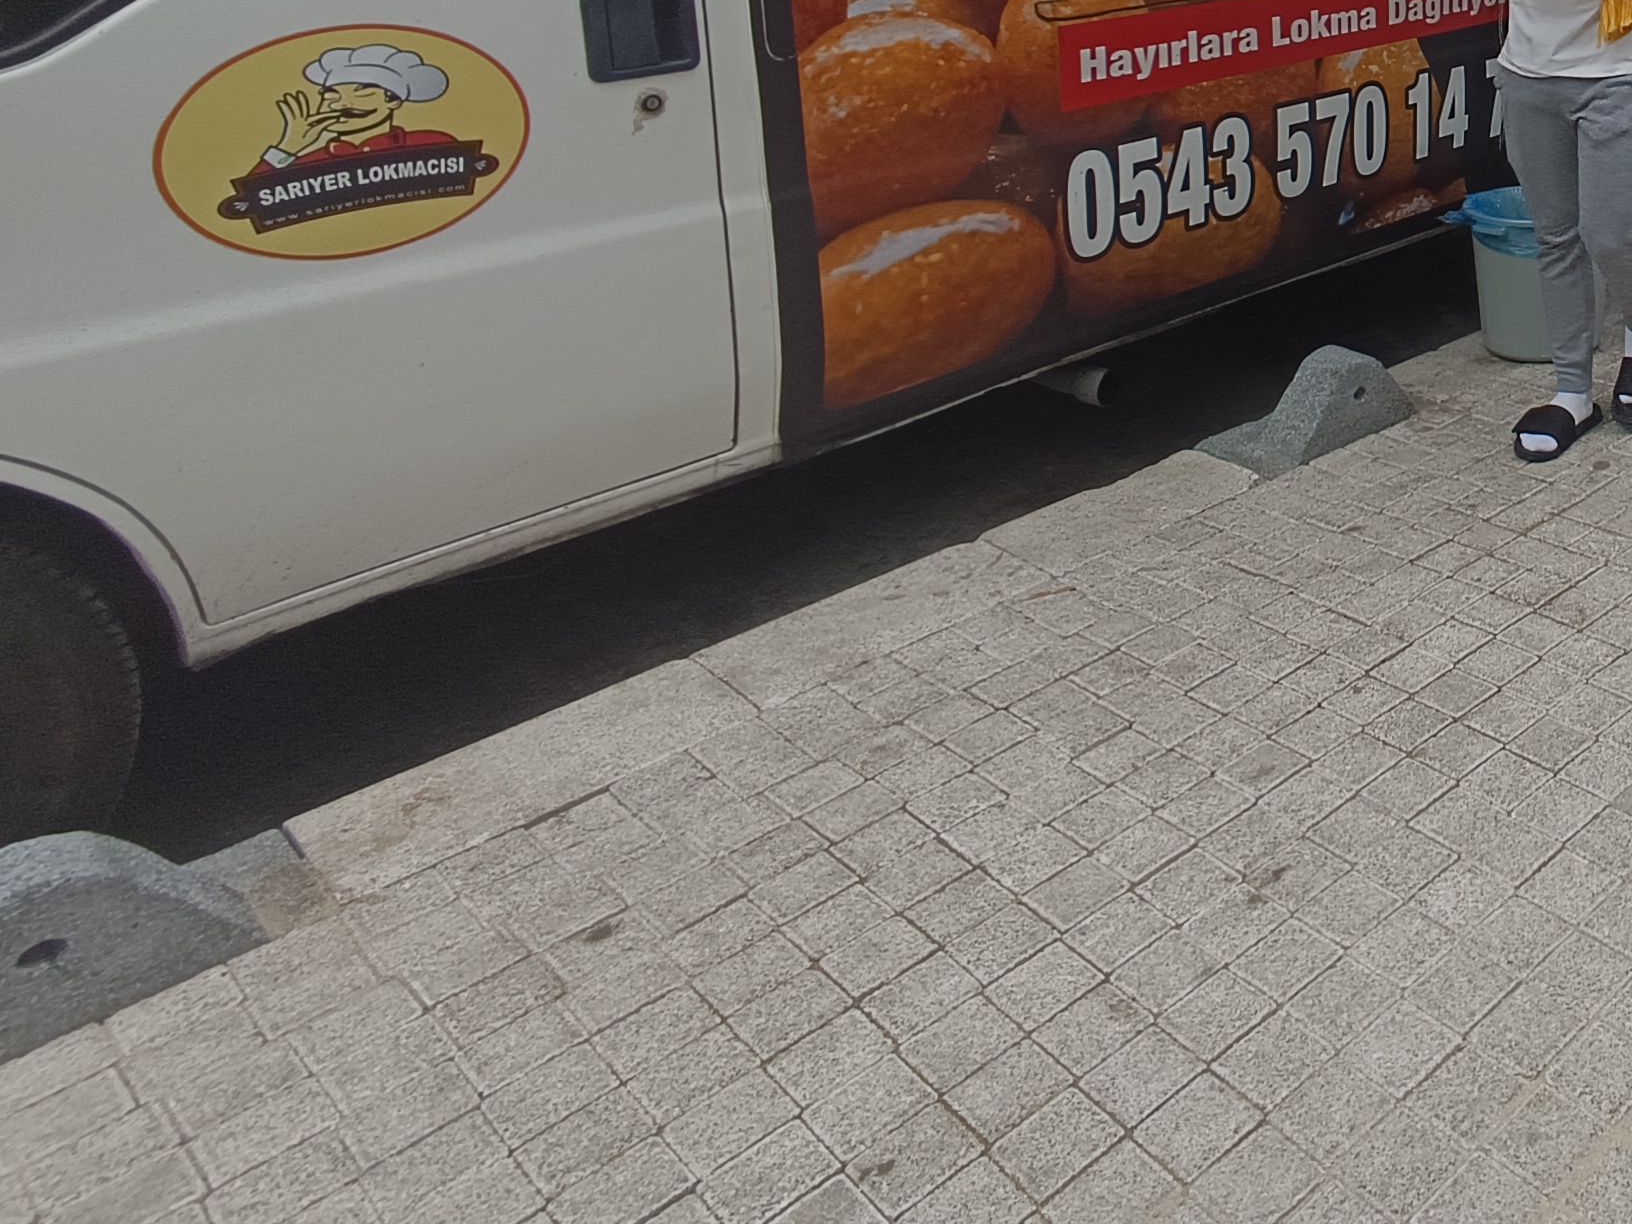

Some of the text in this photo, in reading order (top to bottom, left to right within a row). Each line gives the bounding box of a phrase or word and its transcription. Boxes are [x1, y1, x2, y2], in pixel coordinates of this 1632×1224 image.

[1079, 23, 1258, 83] Hayırlara
[1271, 6, 1377, 47] Lokma
[258, 157, 465, 206] SARIYER LOKMACISI
[1067, 117, 1251, 259] 0543
[1276, 85, 1388, 199] 570
[1408, 66, 1469, 160] 14
